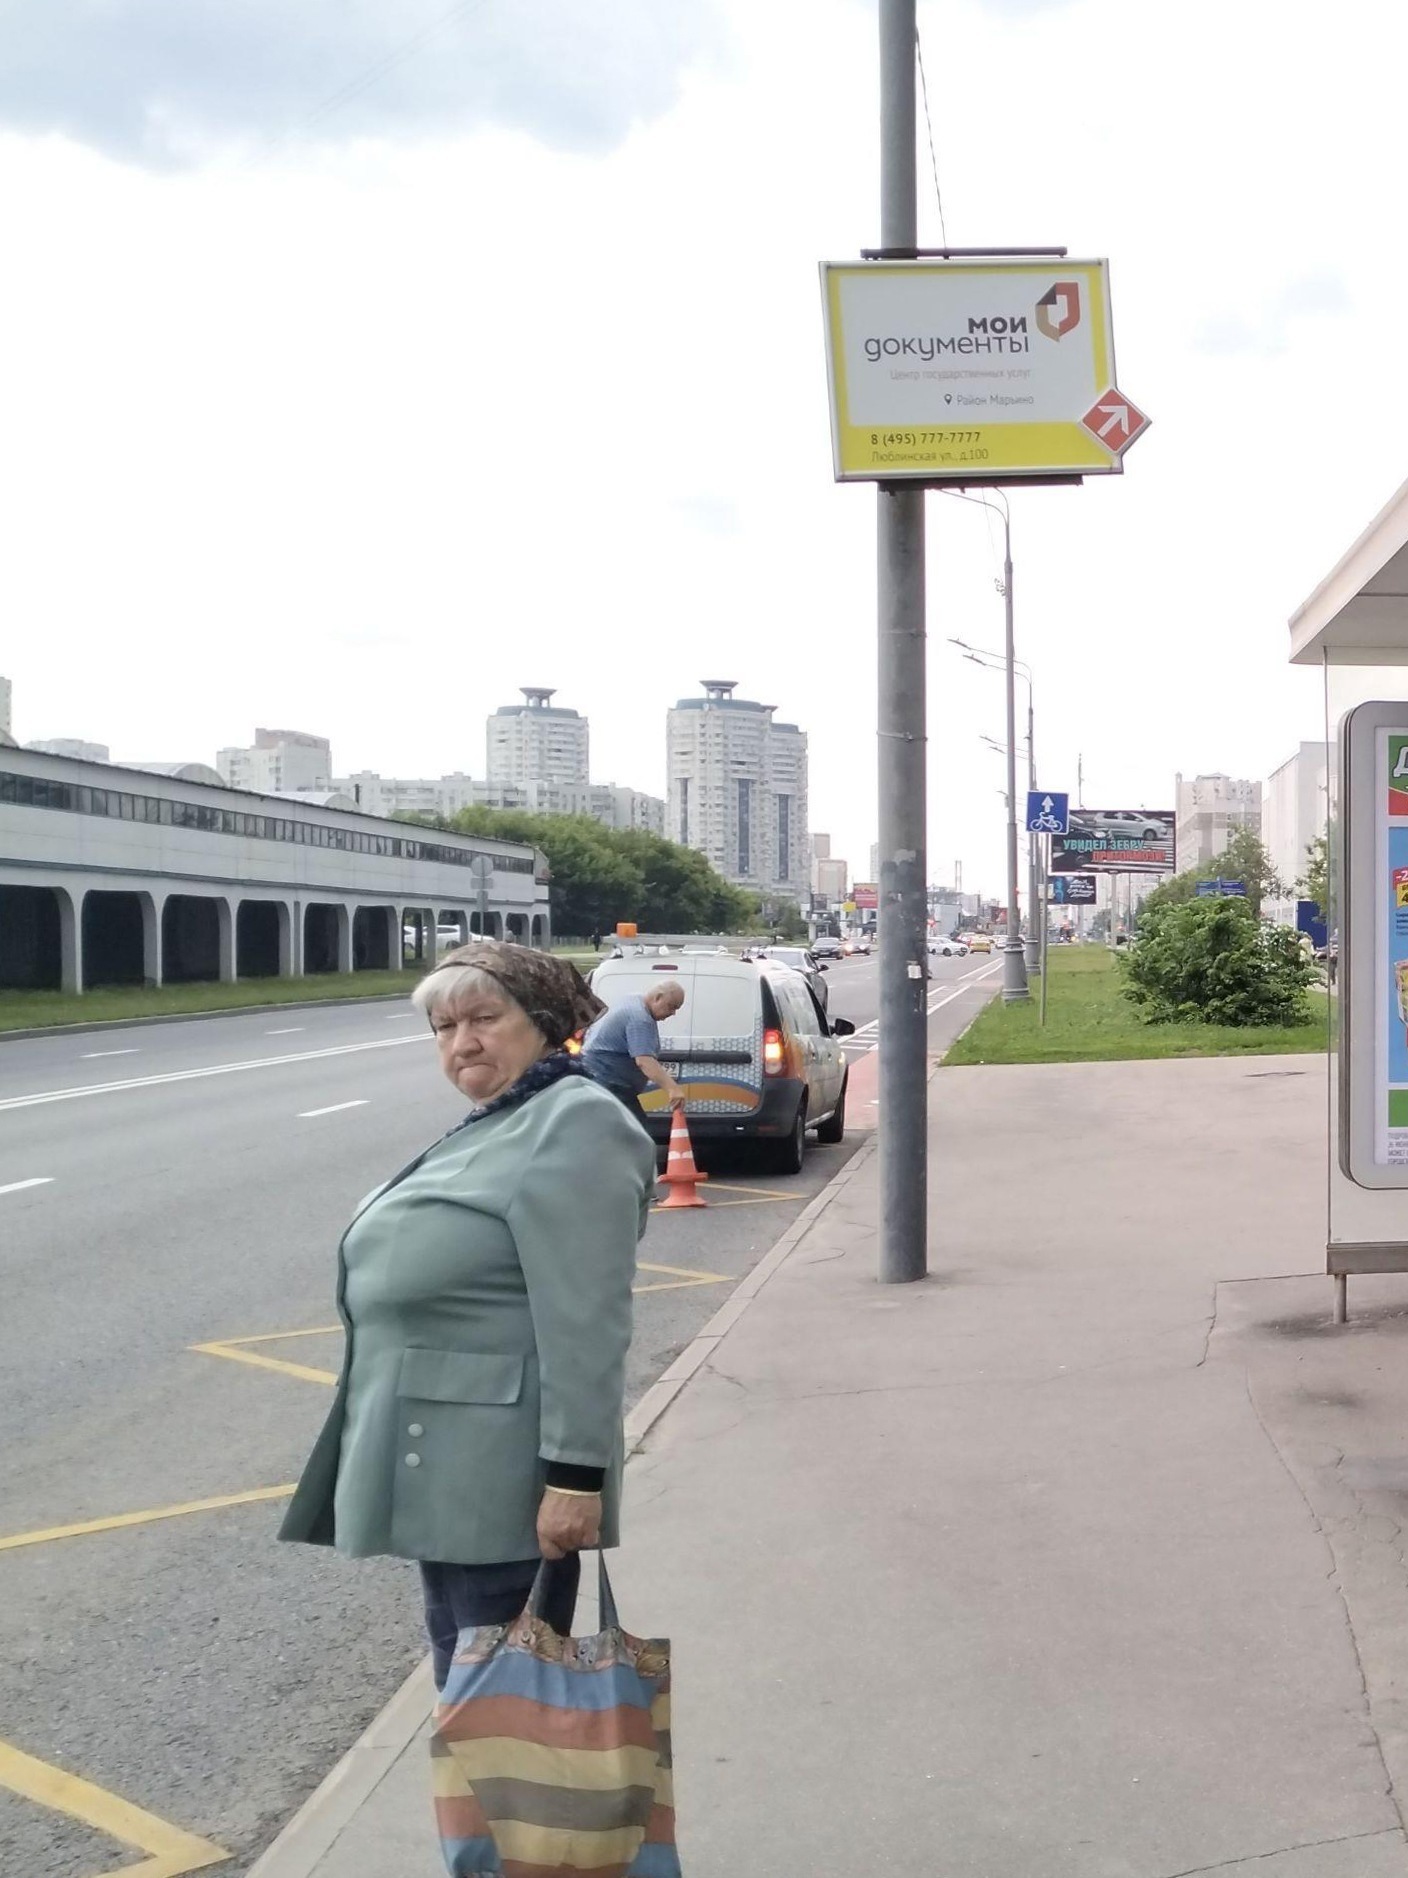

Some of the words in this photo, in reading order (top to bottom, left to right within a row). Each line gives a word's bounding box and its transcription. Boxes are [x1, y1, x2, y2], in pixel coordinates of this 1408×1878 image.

[968, 316, 1028, 334] мои
[864, 336, 1029, 362] документы
[870, 433, 878, 445] 8
[883, 433, 916, 447] (495)
[920, 431, 981, 444] 777-7777
[1063, 839, 1107, 852] УВИДЕЛ
[1109, 839, 1144, 851] ЗЕБРУ
